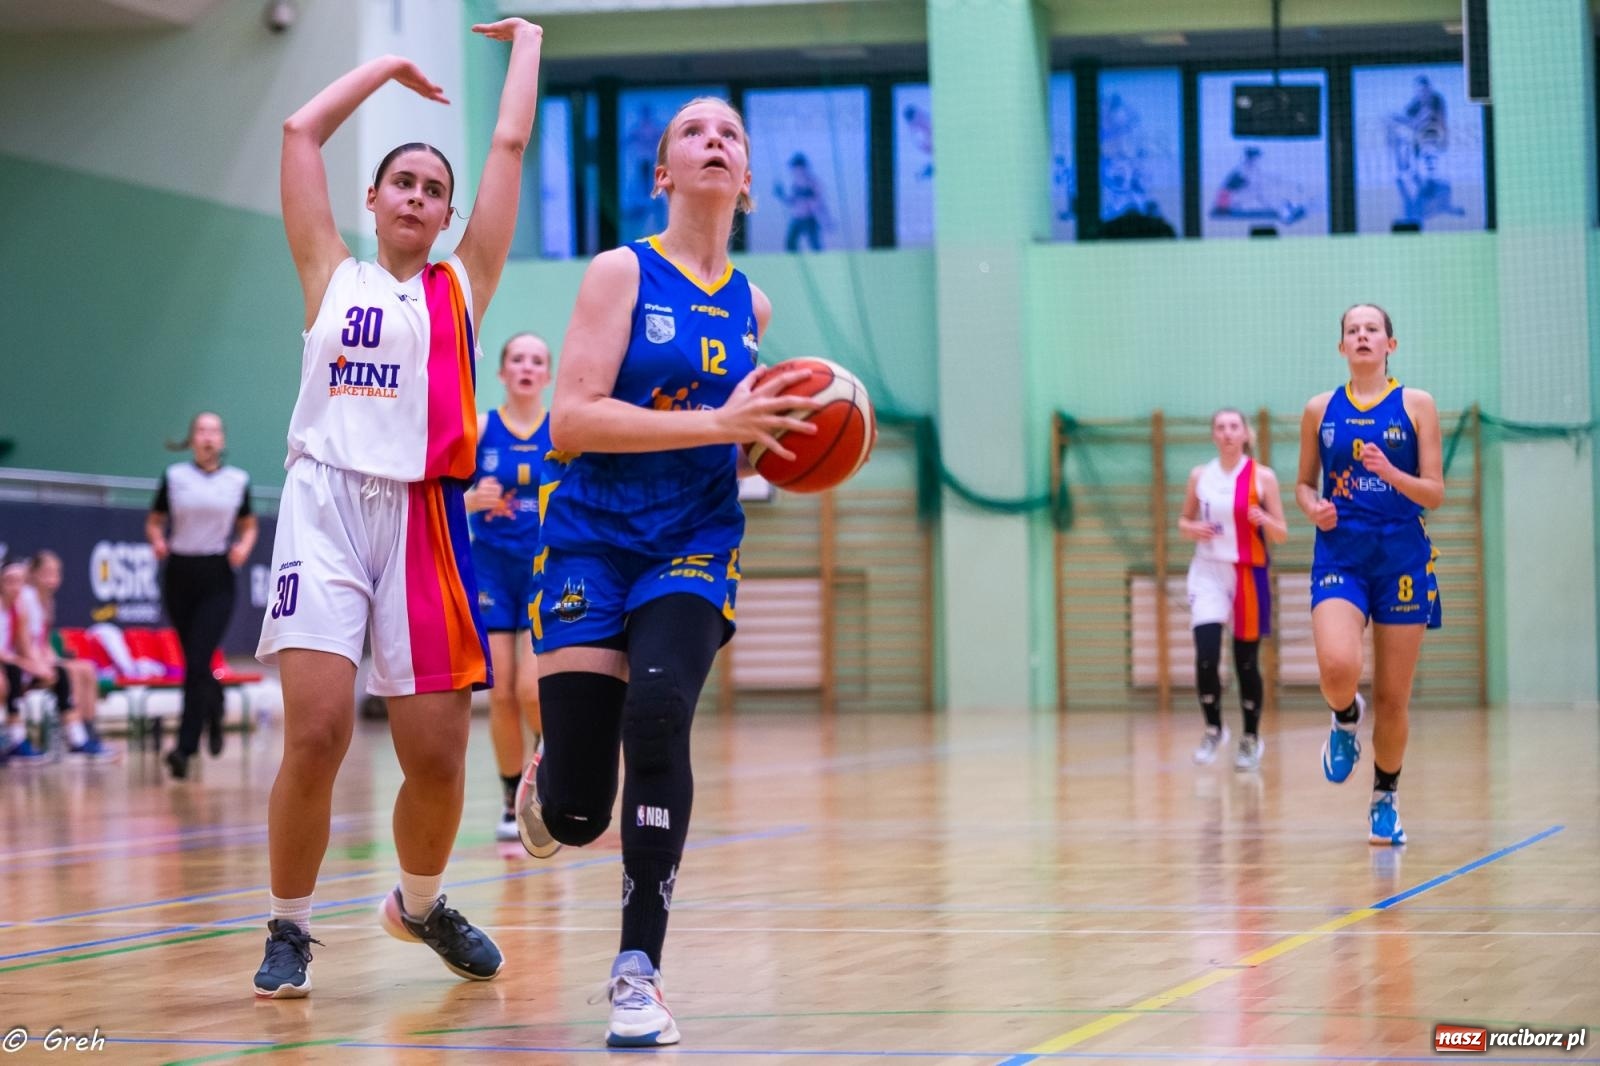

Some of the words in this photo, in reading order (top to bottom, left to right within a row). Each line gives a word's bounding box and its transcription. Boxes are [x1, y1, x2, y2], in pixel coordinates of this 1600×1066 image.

[690, 304, 730, 319] regio
[341, 305, 384, 349] 30
[700, 336, 728, 376] 12
[329, 361, 401, 389] MINI
[1352, 438, 1366, 461] 8
[271, 573, 299, 620] 30
[1397, 574, 1414, 602] 8
[645, 806, 670, 829] NBA
